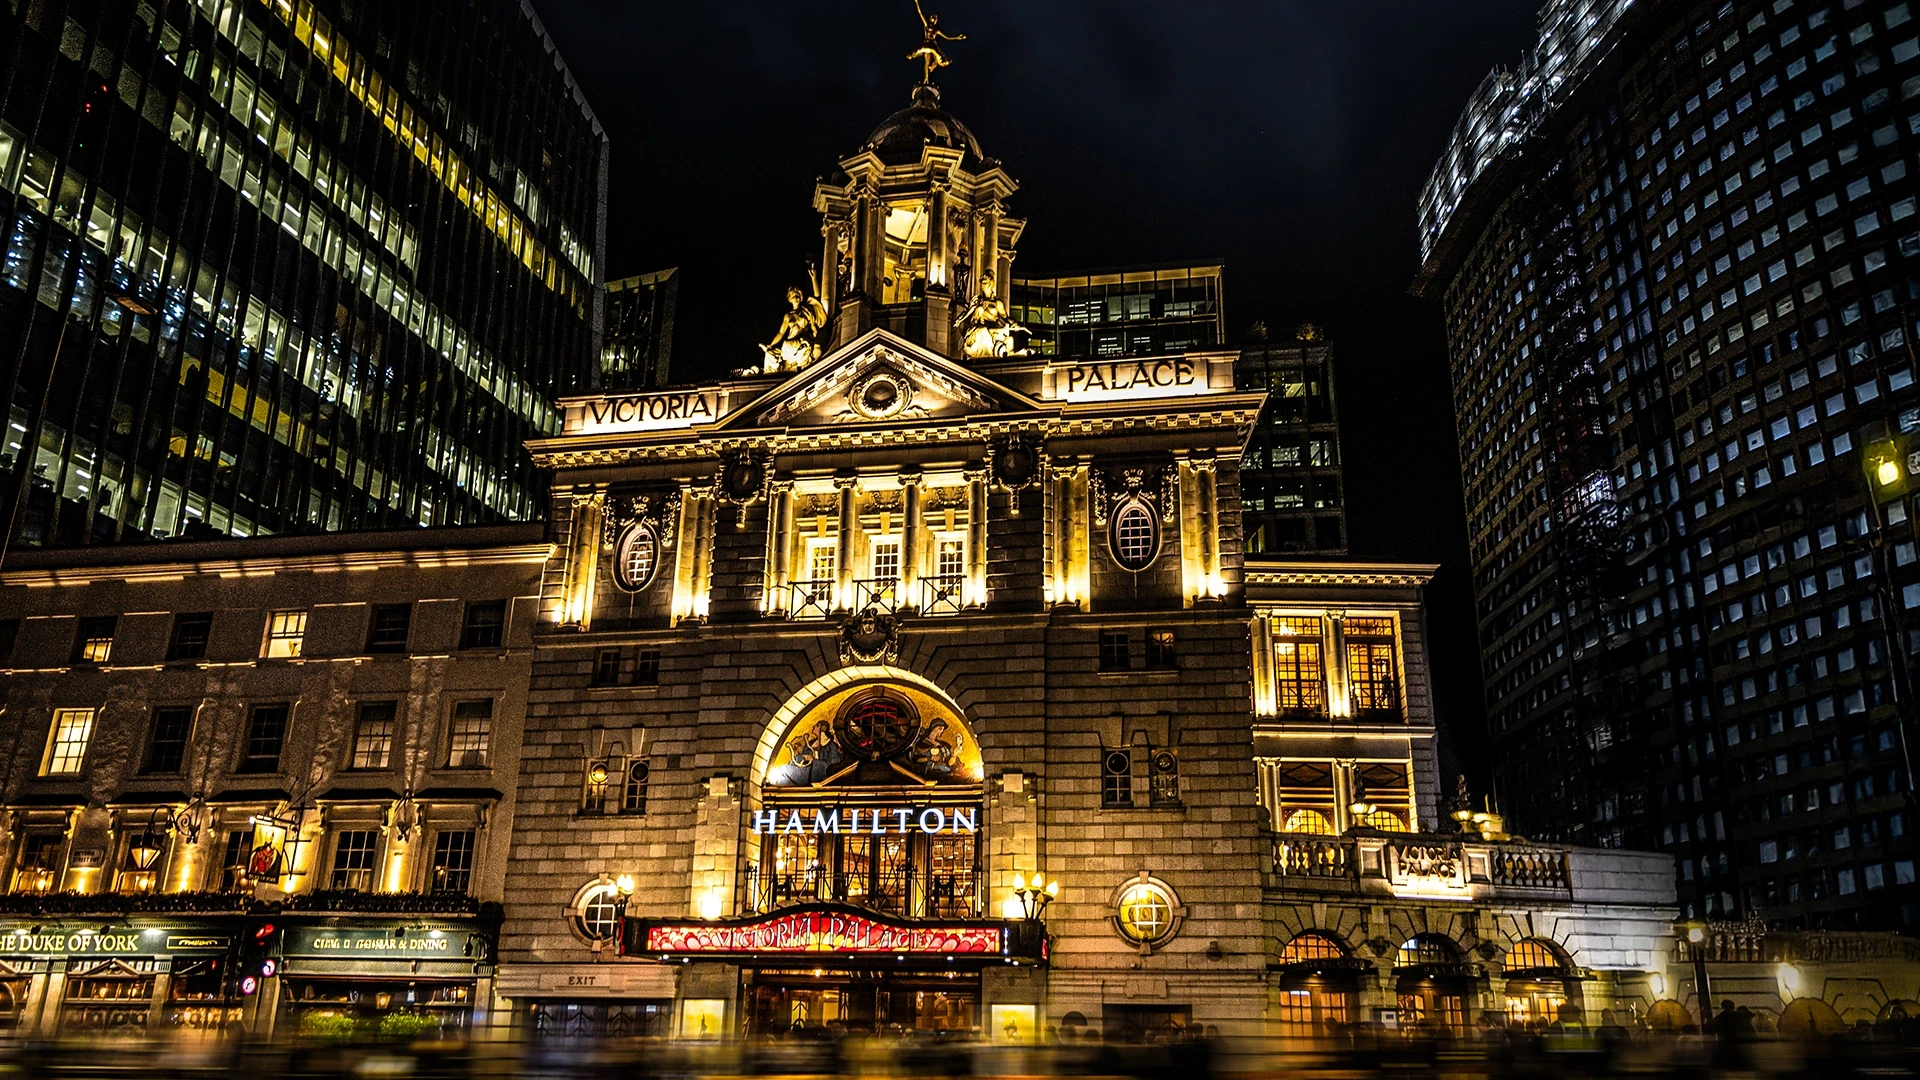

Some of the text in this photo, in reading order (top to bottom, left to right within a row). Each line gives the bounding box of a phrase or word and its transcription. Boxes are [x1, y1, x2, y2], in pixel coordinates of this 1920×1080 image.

[1068, 359, 1195, 393] PALACE
[589, 394, 712, 425] VICTORIA
[753, 808, 976, 834] HAMILTON
[19, 934, 65, 951] DUKE
[67, 934, 92, 951] OF
[93, 934, 140, 951] YORK
[410, 939, 447, 950] DINING
[716, 917, 930, 949] VICTORIA PALACE
[568, 976, 596, 986] EXIT
